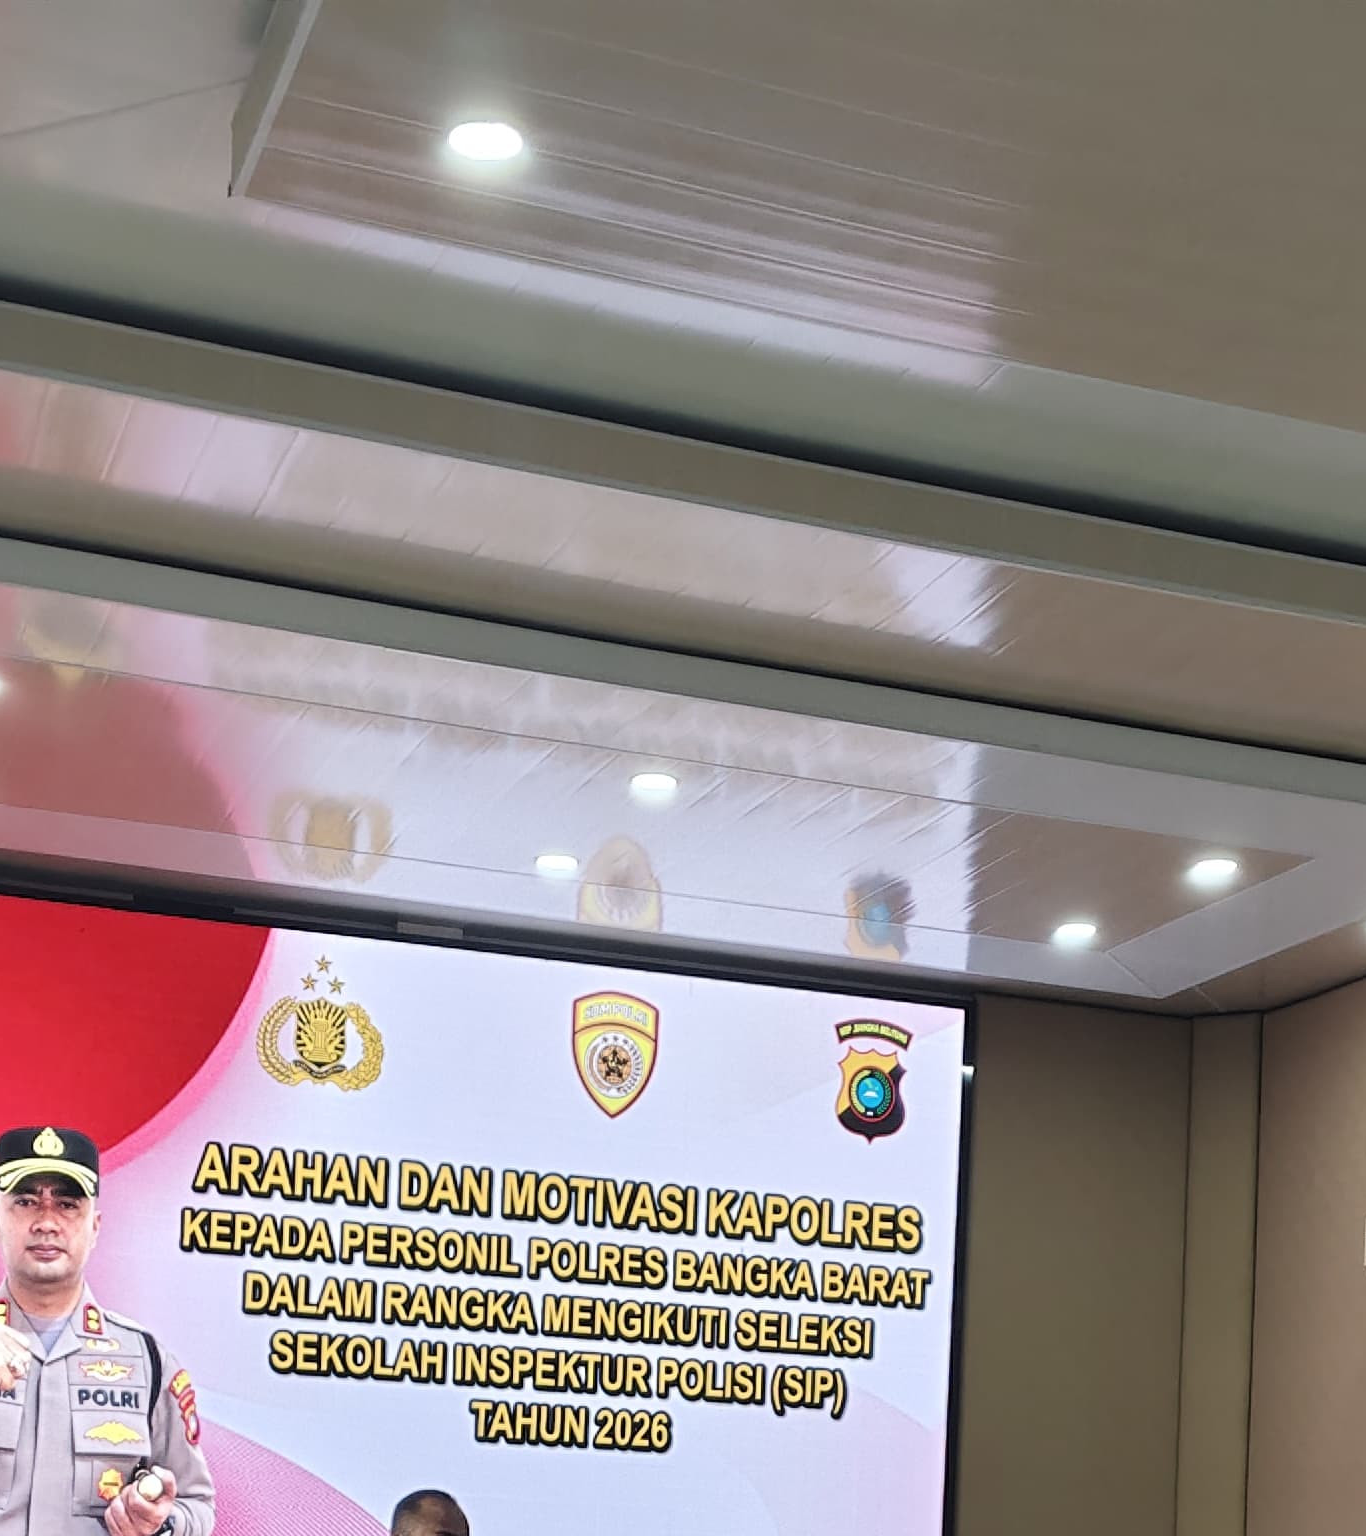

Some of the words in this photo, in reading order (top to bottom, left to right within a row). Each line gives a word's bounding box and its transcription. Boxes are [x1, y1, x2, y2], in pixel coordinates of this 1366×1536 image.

[193, 1142, 389, 1208] ARAHAN
[399, 1159, 492, 1217] DAN
[502, 1169, 697, 1235] MOTIVASI
[706, 1188, 923, 1253] KAPOLRES
[180, 1207, 335, 1261] KEPADA
[340, 1221, 521, 1278] PERSONIL
[528, 1235, 666, 1288] POLRES
[673, 1249, 816, 1300] BANGKA
[821, 1261, 931, 1310] BARAT
[243, 1270, 375, 1322] DALAM
[382, 1281, 536, 1333] RANGKA
[541, 1294, 729, 1349] MENGIKUTI
[733, 1308, 874, 1359] SELEKSI
[78, 1388, 140, 1409] POLRI
[269, 1330, 446, 1384] SEKOLAH
[453, 1343, 651, 1397] INSPEKTUR
[656, 1357, 766, 1405] POLISI
[771, 1365, 847, 1419] (SIP)
[469, 1399, 588, 1447] TAHUN
[593, 1408, 672, 1452] 2026
